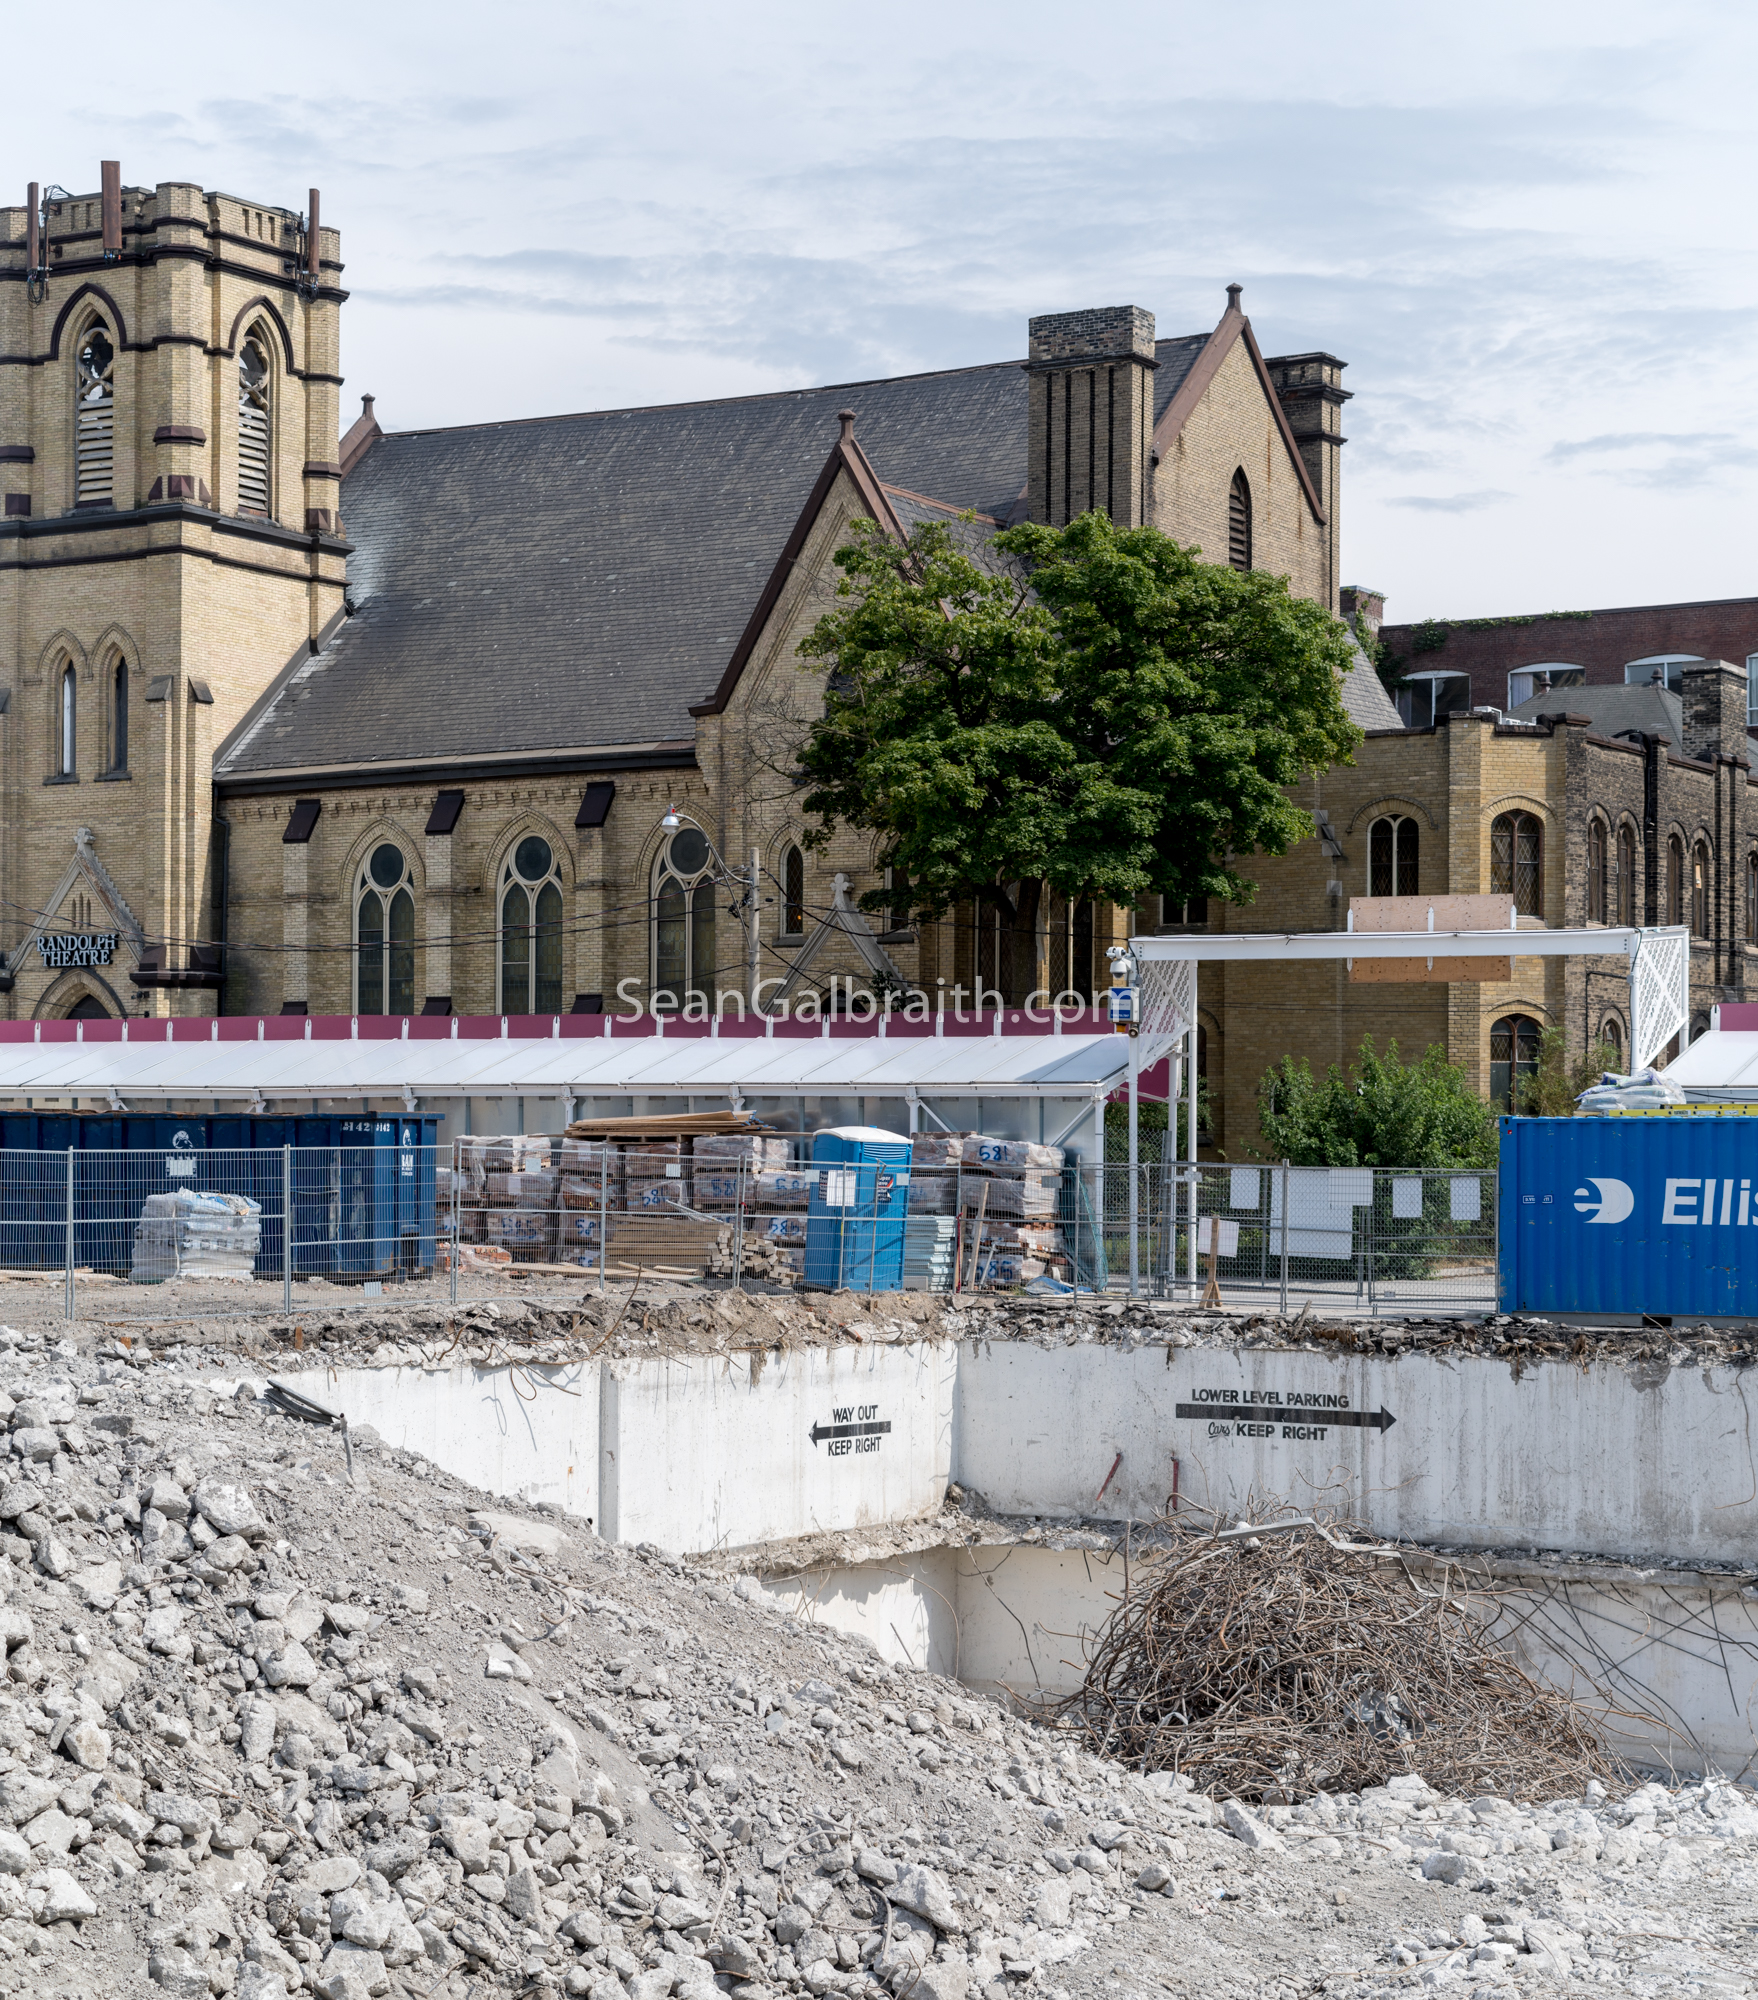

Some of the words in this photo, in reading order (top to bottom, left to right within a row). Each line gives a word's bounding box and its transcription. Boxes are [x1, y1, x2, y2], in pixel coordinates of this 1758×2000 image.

[36, 934, 116, 952] RANDOLPH
[40, 949, 110, 967] THEATRE
[979, 1145, 1008, 1162] 581
[1661, 1178, 1758, 1226] Elli
[1191, 1388, 1239, 1403] LOWER
[1242, 1390, 1284, 1405] LEVEL
[1286, 1392, 1350, 1409] PARKING
[832, 1407, 855, 1423] WAY
[857, 1404, 879, 1421] OUT
[1207, 1421, 1232, 1438] Cars
[1236, 1423, 1276, 1438] KEEP
[1282, 1425, 1328, 1441] RIGHT
[828, 1439, 852, 1456] KEEP
[855, 1436, 882, 1453] RIGHT
